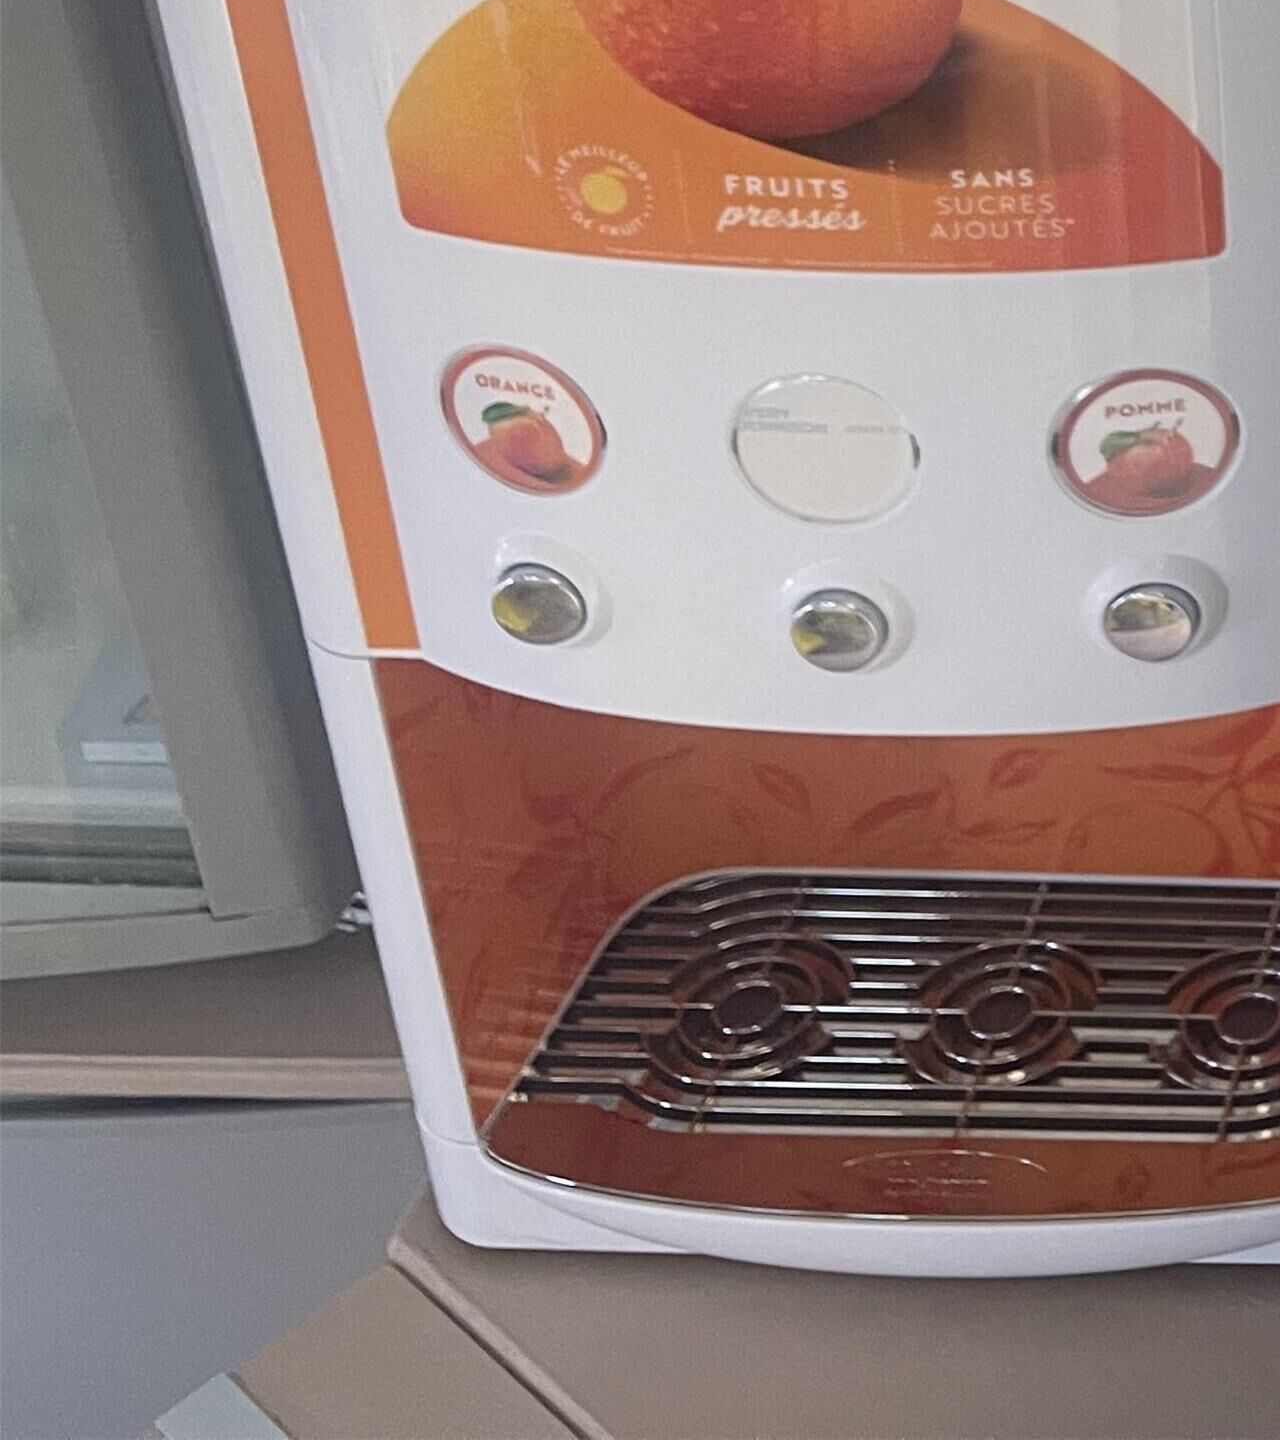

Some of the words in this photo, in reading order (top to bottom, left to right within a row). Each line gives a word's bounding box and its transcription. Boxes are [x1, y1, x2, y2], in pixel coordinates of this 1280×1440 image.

[723, 173, 849, 200] FRUITS
[950, 166, 1035, 189] SANS
[716, 202, 867, 233] pressés
[474, 372, 556, 401] ORANGE
[1104, 398, 1186, 419] POMME
